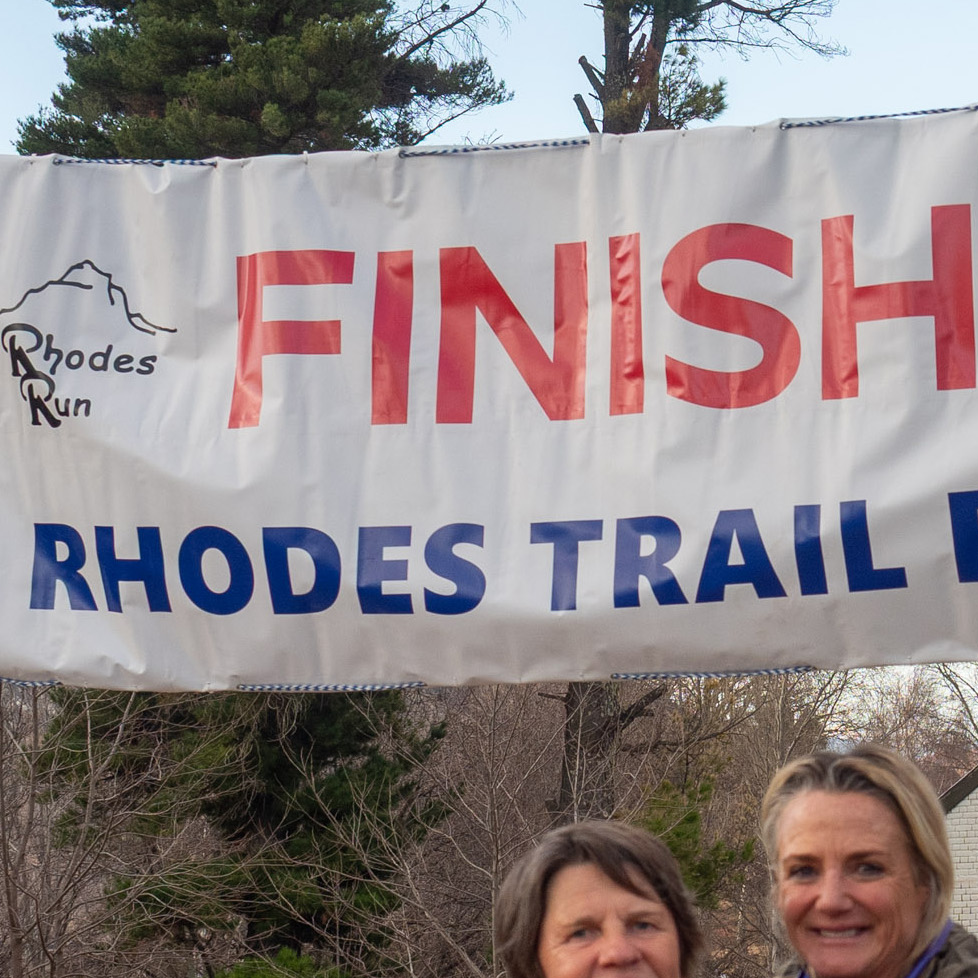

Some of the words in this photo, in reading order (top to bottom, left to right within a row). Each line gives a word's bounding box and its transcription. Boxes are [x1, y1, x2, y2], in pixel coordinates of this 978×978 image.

[1, 323, 158, 378] Rhodes
[228, 204, 977, 429] FINISH
[19, 369, 92, 429] Run
[29, 523, 487, 616] RHODES
[530, 501, 908, 609] TRAIL
